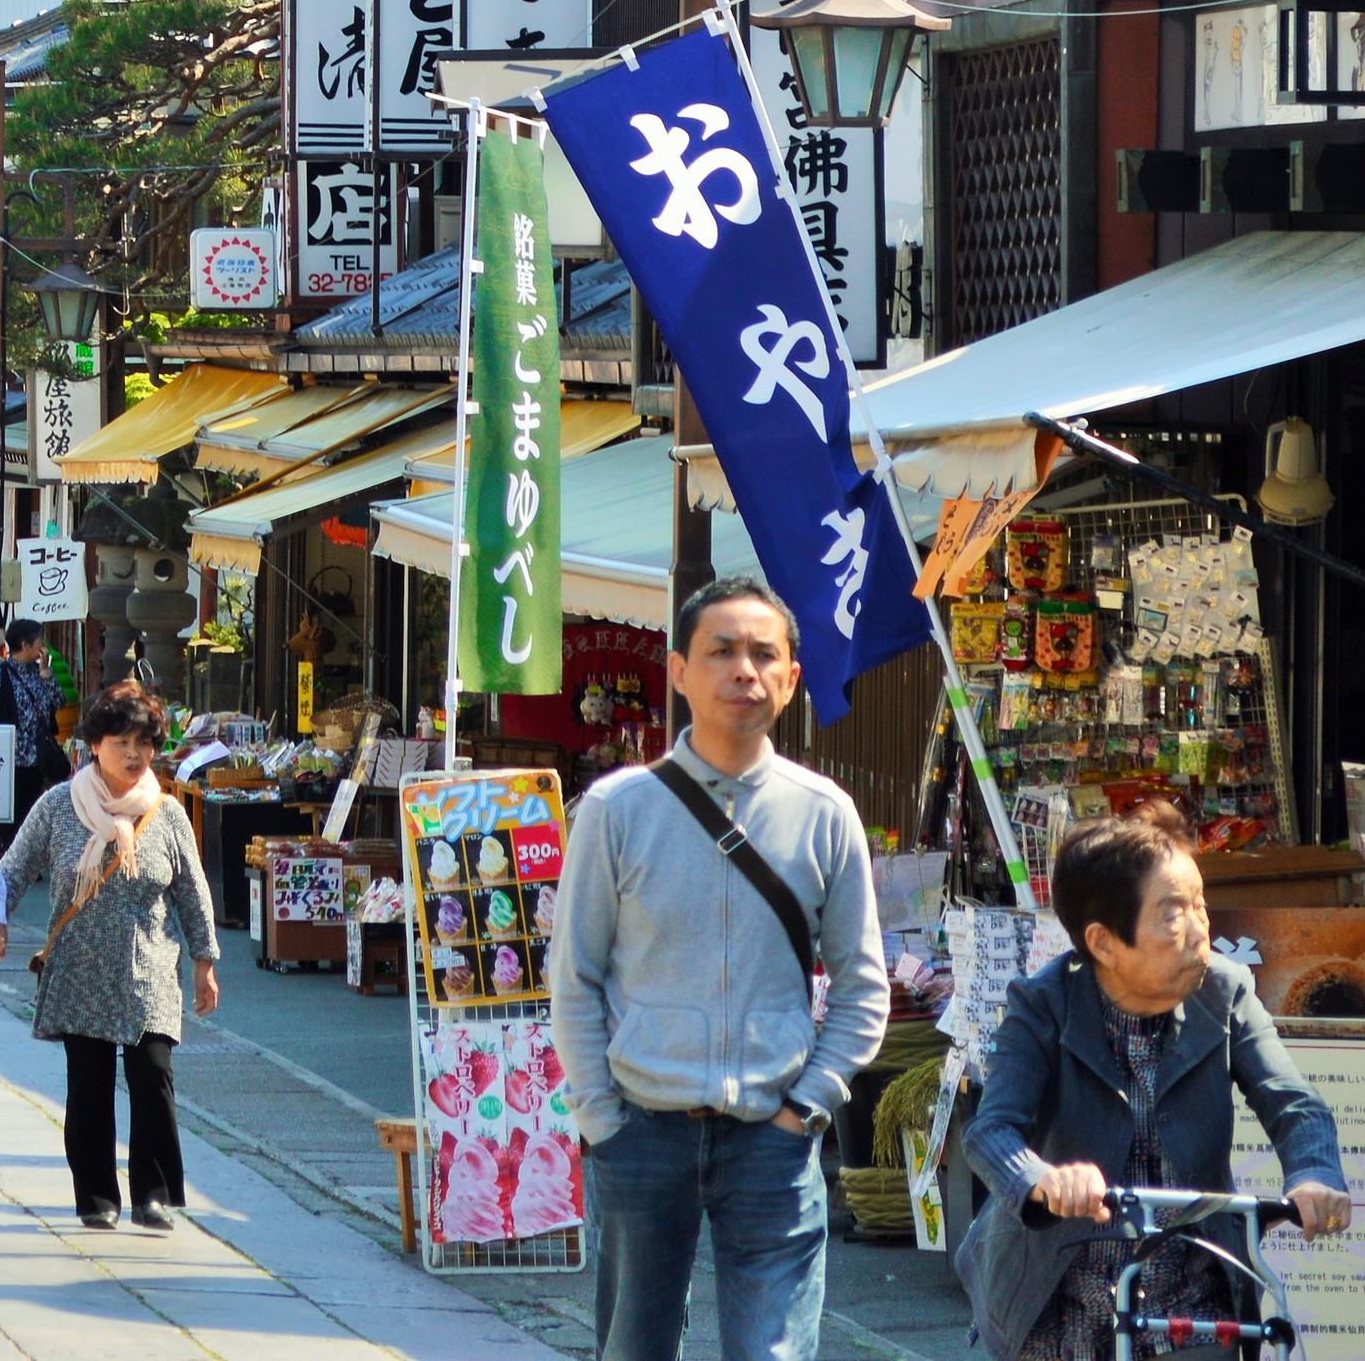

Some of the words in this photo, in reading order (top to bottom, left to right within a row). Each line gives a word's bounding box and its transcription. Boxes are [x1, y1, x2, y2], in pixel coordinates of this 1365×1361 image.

[330, 254, 370, 271] TEL
[628, 102, 871, 640] おやき
[29, 546, 78, 565] コーヒー
[518, 843, 560, 861] 300円
[452, 1029, 476, 1136] ストロベリー
[525, 1024, 548, 1133] ストロベリー
[1299, 1271, 1326, 1281] secret
[1306, 1283, 1320, 1293] the
[1324, 1285, 1345, 1294] oven
